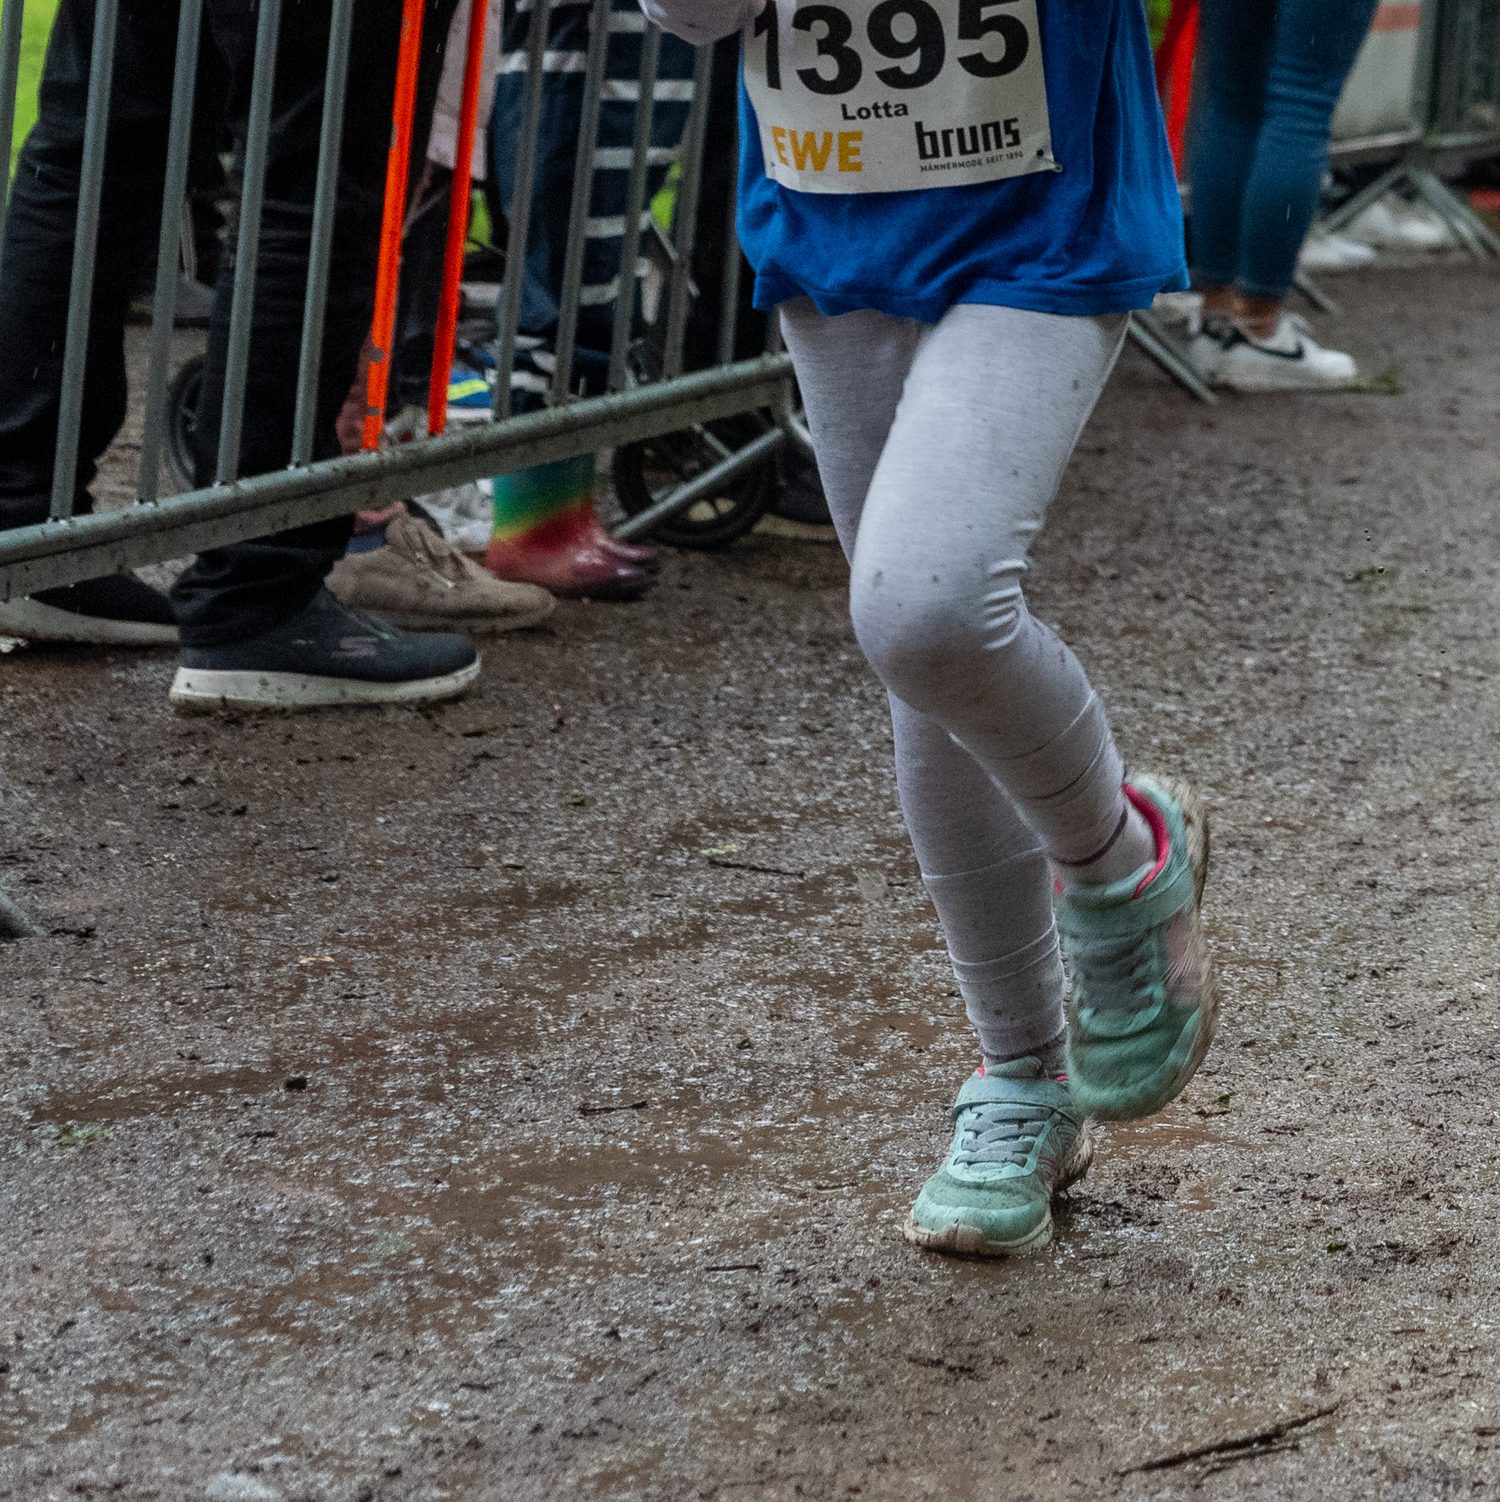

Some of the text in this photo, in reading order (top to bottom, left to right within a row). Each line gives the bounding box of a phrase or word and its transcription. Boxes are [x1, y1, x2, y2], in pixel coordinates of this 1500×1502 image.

[840, 101, 909, 121] Lotta
[771, 117, 1021, 172] EWE bruns
